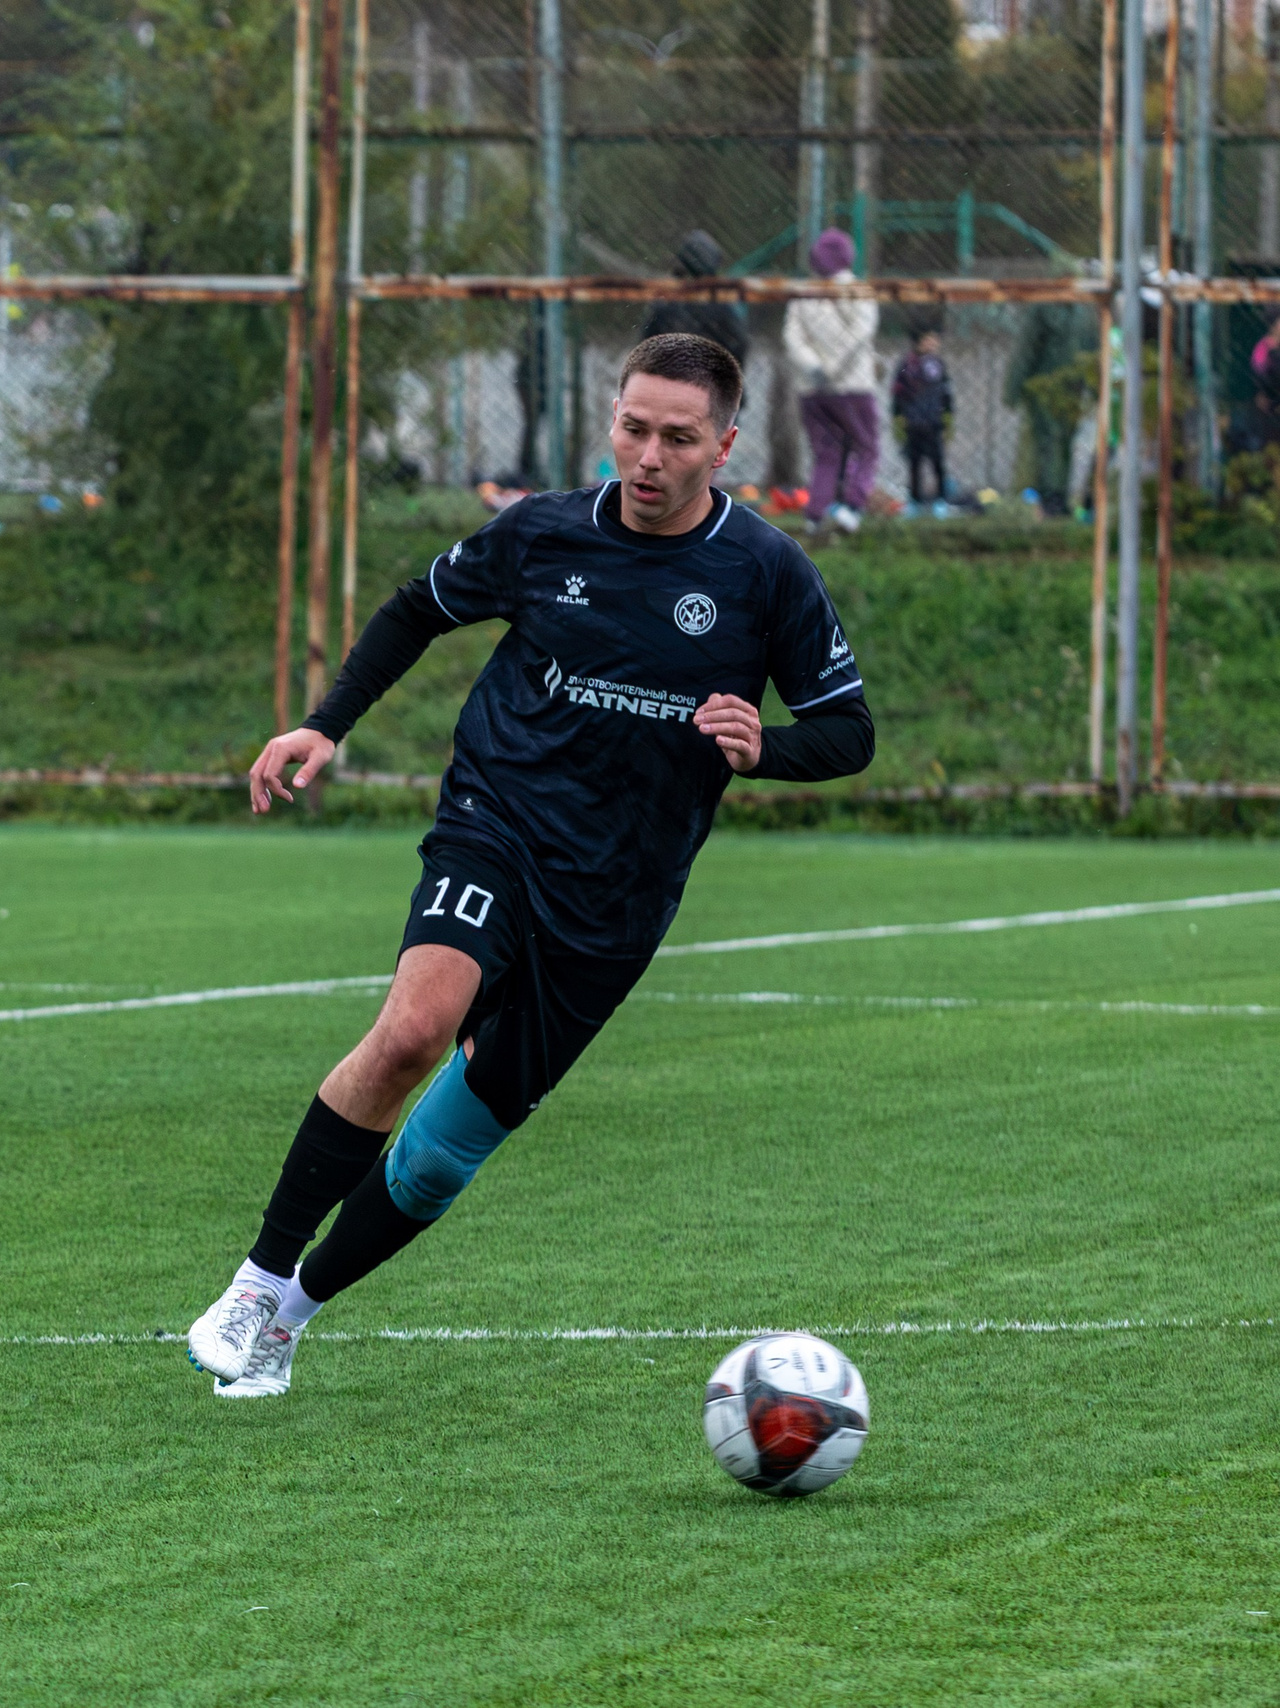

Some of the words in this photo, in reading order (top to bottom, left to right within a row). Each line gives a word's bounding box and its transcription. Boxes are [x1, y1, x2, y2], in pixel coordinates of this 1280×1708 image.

[556, 594, 590, 606] KELME
[564, 685, 695, 723] TATNEFT
[568, 675, 667, 701] БЛАГОТВОРИТЕЛЬНЫЙ
[669, 694, 697, 707] ФОНД
[422, 876, 494, 928] 10
